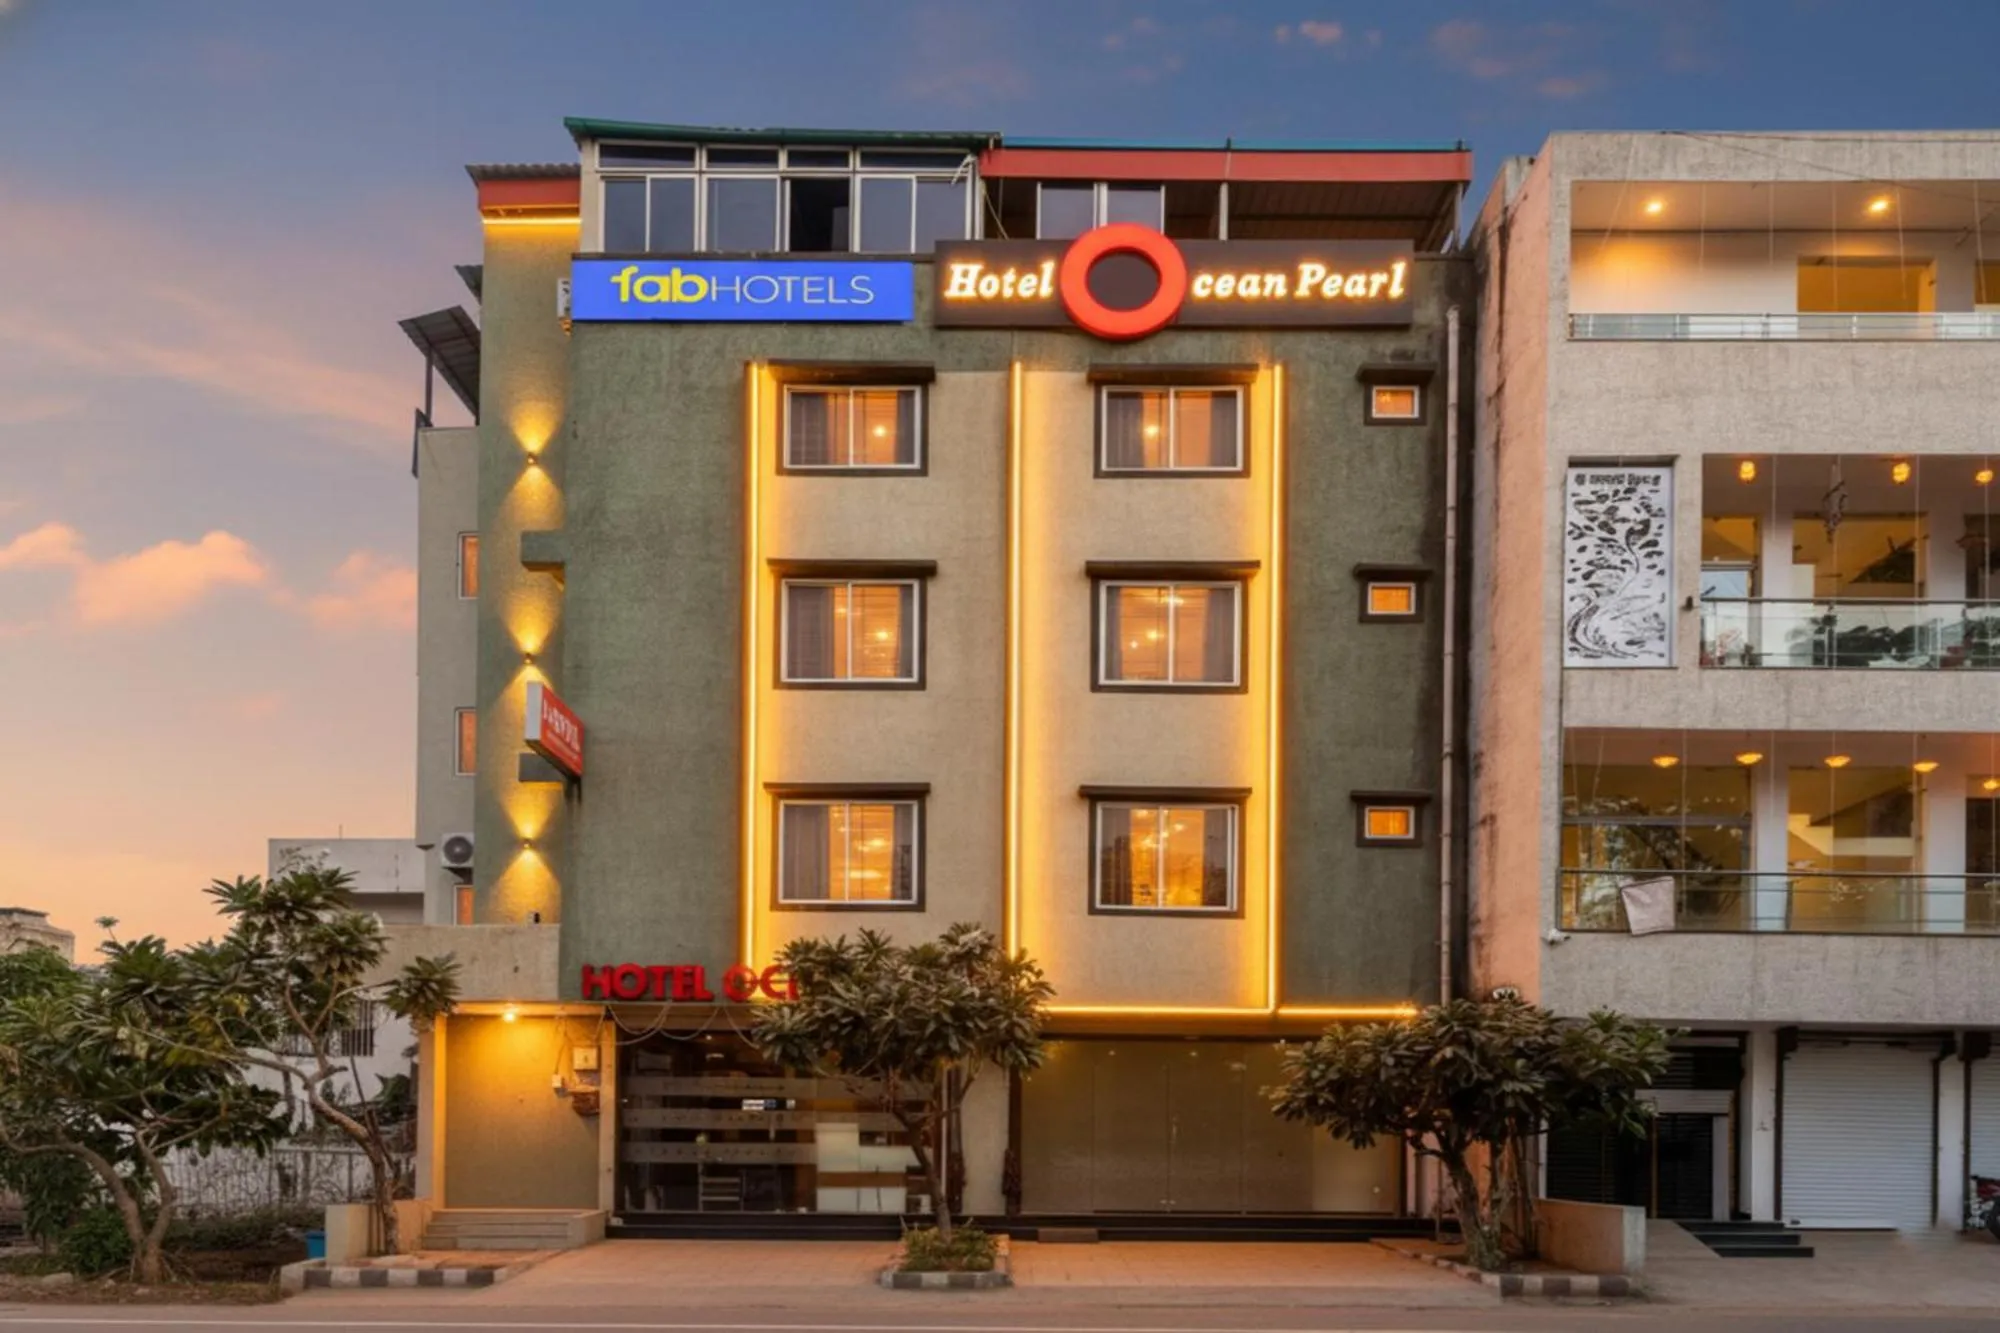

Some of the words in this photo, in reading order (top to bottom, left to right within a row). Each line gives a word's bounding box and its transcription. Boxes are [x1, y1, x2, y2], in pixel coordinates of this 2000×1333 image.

[945, 262, 1055, 298] Hotel
[1296, 261, 1407, 298] Pearl
[581, 963, 714, 1001] HOTEL
